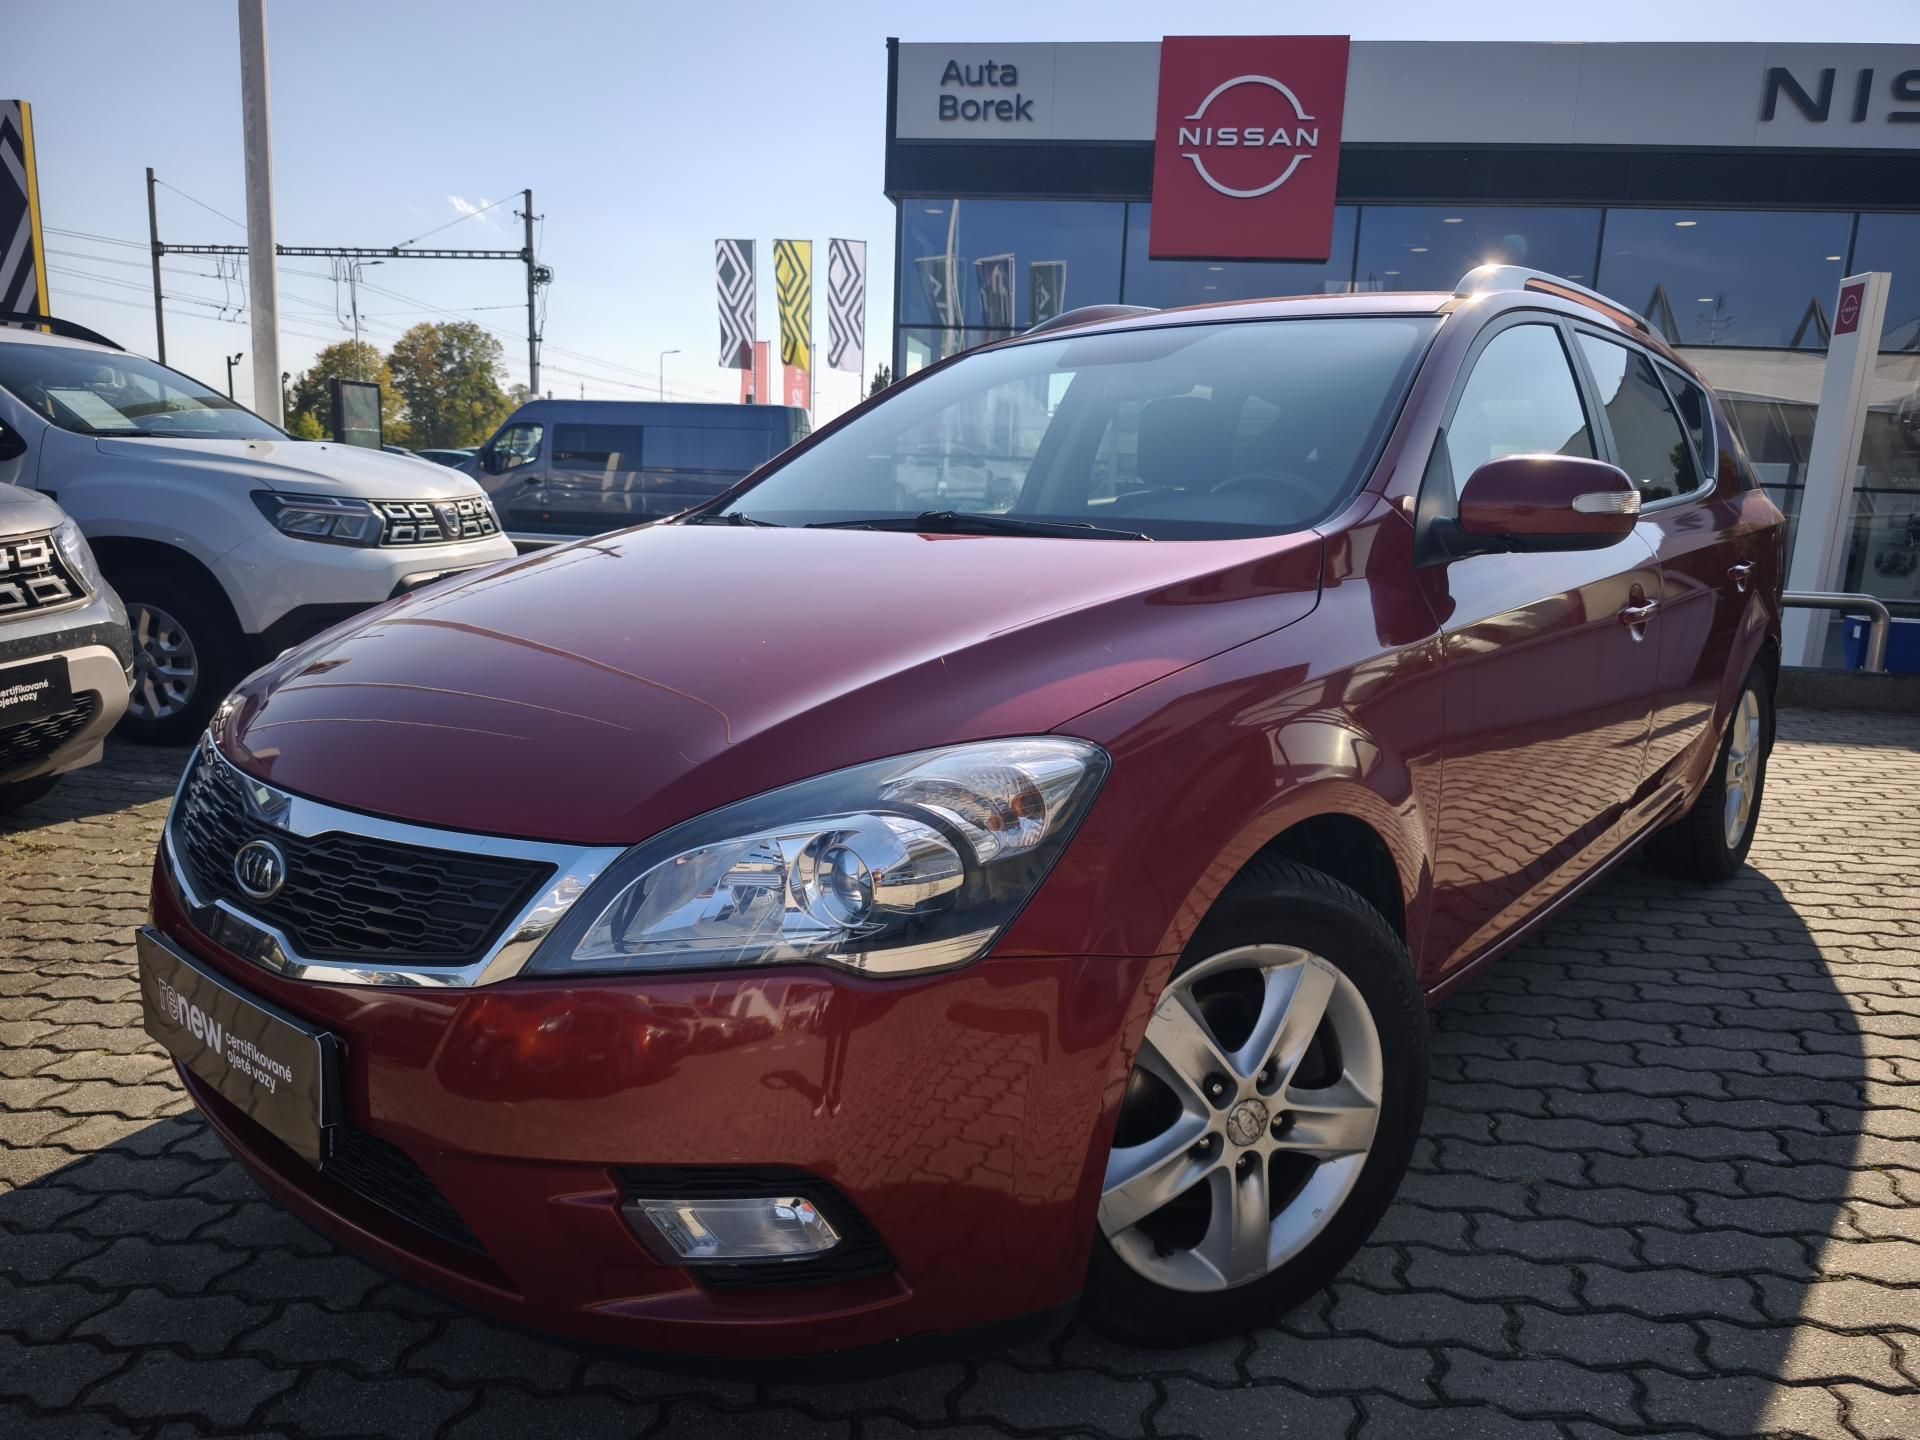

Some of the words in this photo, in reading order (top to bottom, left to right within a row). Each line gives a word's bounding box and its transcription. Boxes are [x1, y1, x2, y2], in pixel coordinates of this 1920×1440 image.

[940, 59, 1018, 87] Auta
[939, 94, 1034, 122] Borek
[1179, 127, 1318, 147] NISSAN
[0, 679, 49, 697] ertifikované
[19, 691, 38, 702] vozy
[241, 849, 274, 890] KIA
[158, 977, 222, 1054] renew
[225, 1031, 292, 1083] certifikované
[227, 1050, 251, 1075] ojeté
[252, 1066, 276, 1094] vozy
